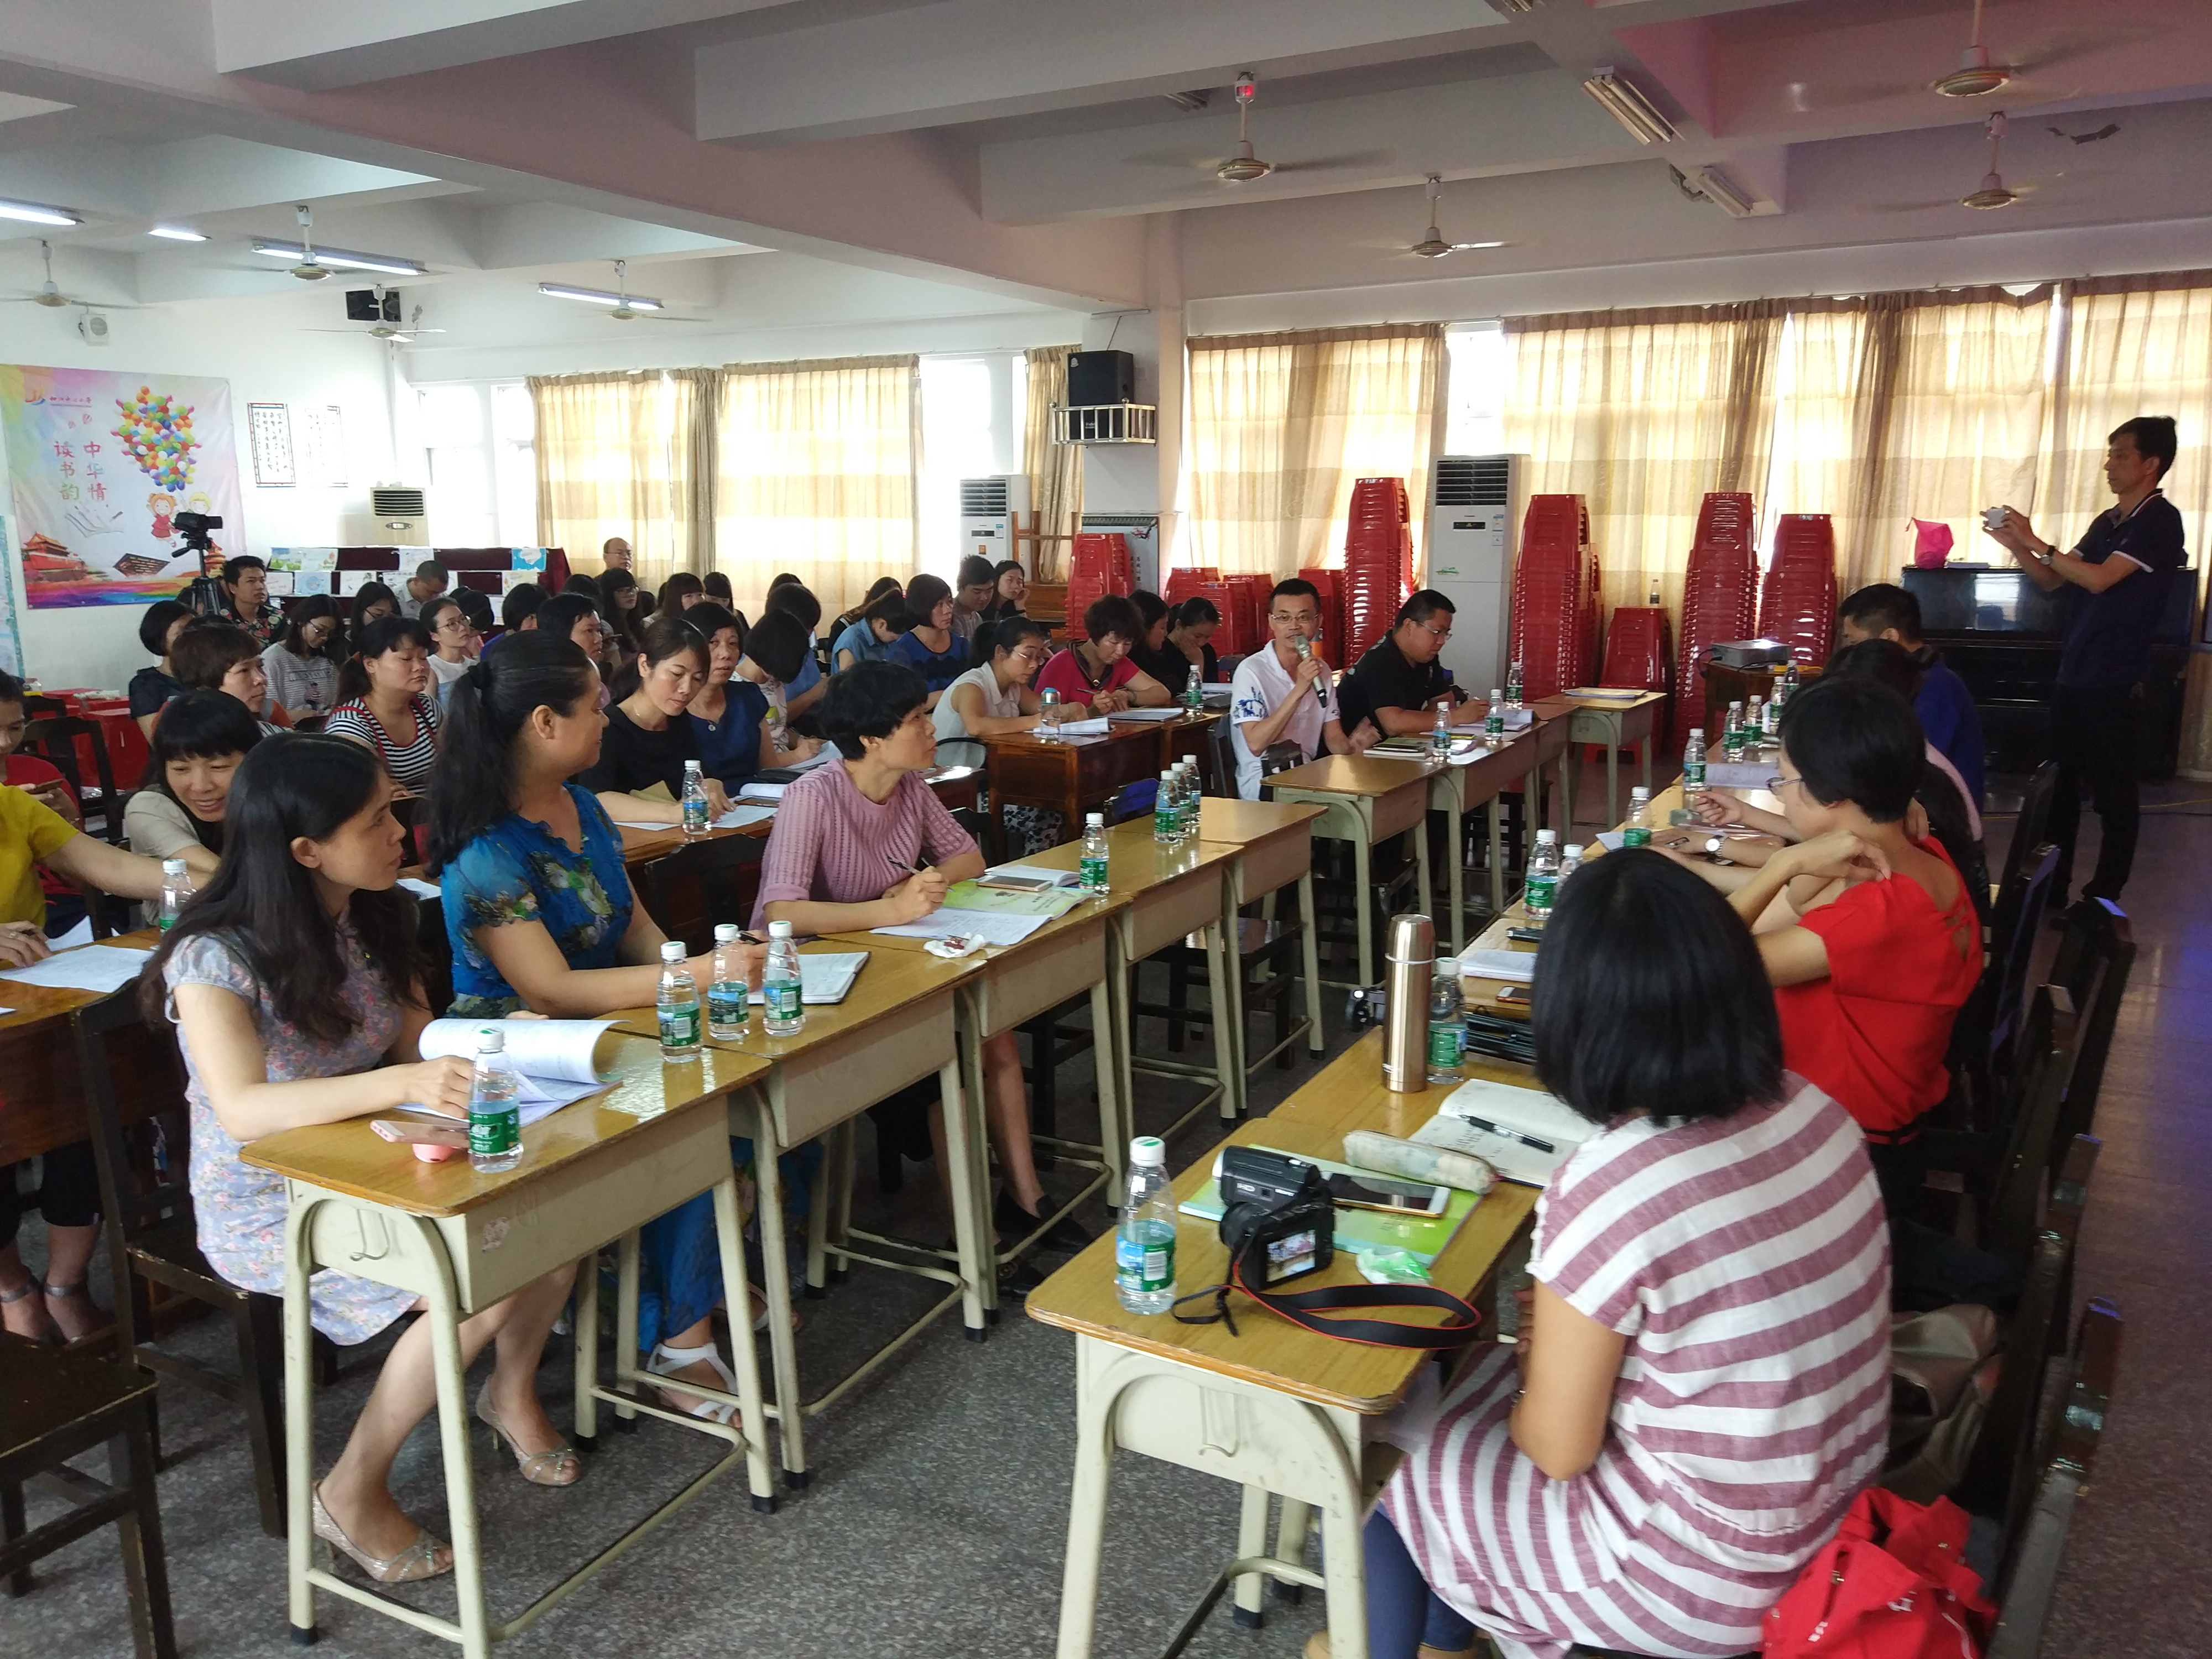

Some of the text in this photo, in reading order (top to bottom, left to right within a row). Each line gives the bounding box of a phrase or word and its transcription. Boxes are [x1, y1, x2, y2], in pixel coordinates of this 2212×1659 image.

[54, 441, 80, 500] 读书韵
[83, 441, 107, 500] 中华情
